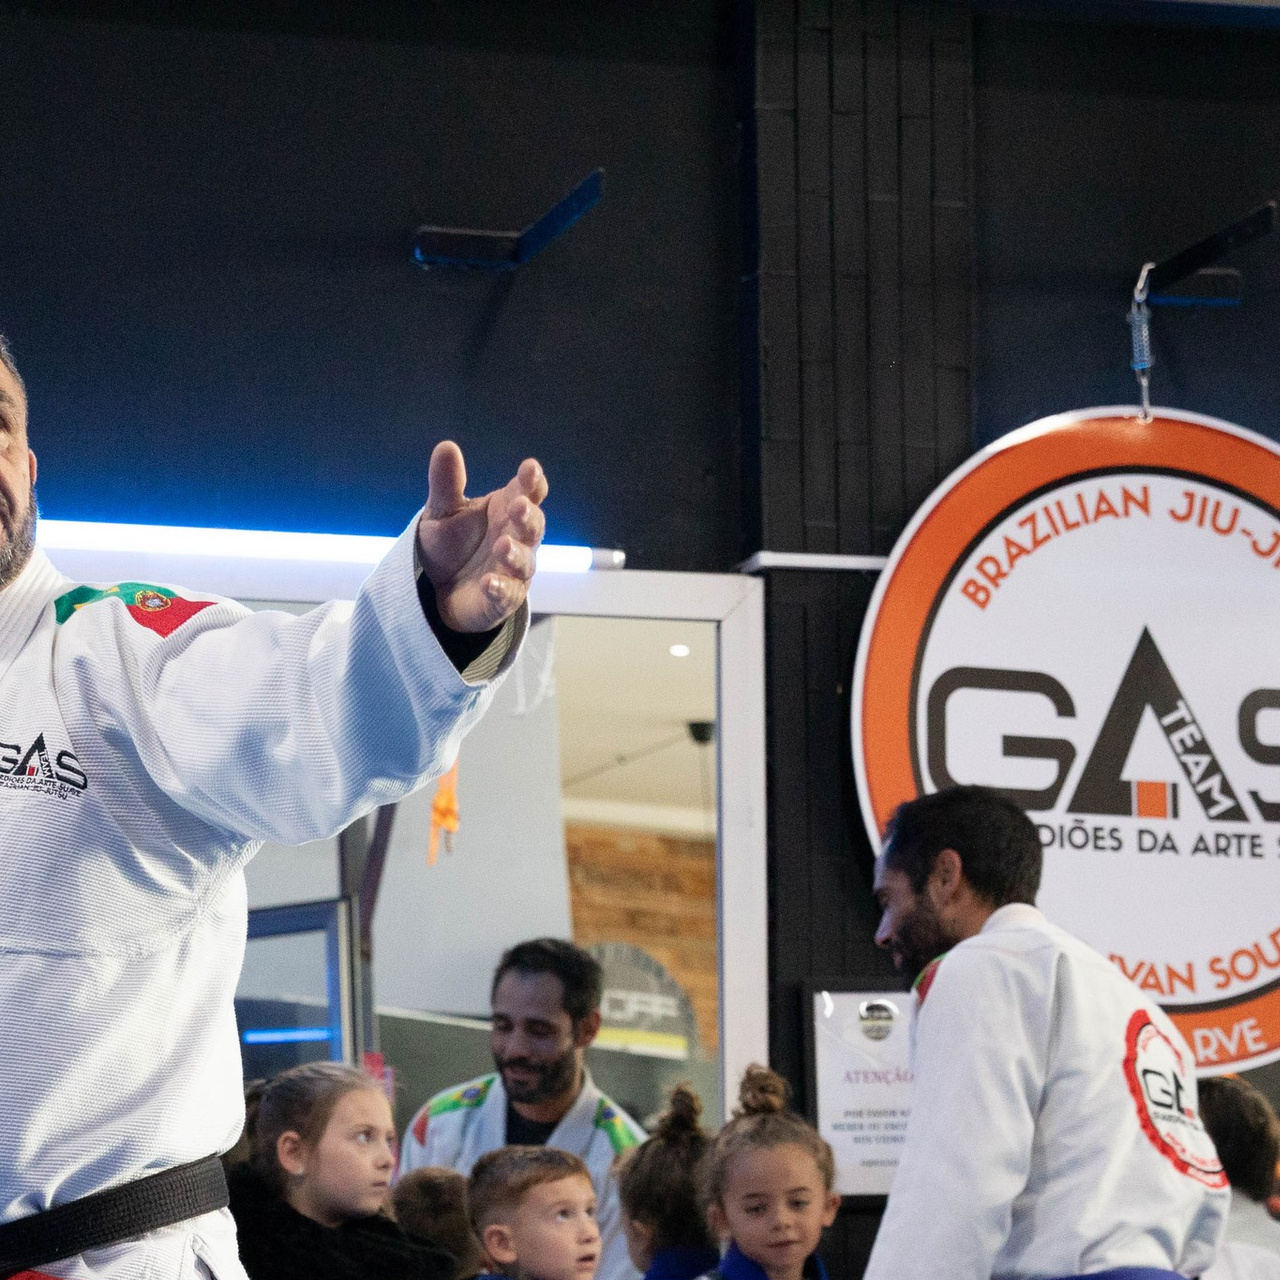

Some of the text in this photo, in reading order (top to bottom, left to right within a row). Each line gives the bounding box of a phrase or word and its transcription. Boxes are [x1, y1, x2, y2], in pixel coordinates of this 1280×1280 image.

[960, 484, 1280, 610] BRAZILIAN JIU-J
[1160, 700, 1238, 820] TEAM
[1034, 818, 1264, 859] DIÕES DA ARTE
[1108, 925, 1280, 996] VAN SOU
[1192, 1017, 1267, 1064] RVE
